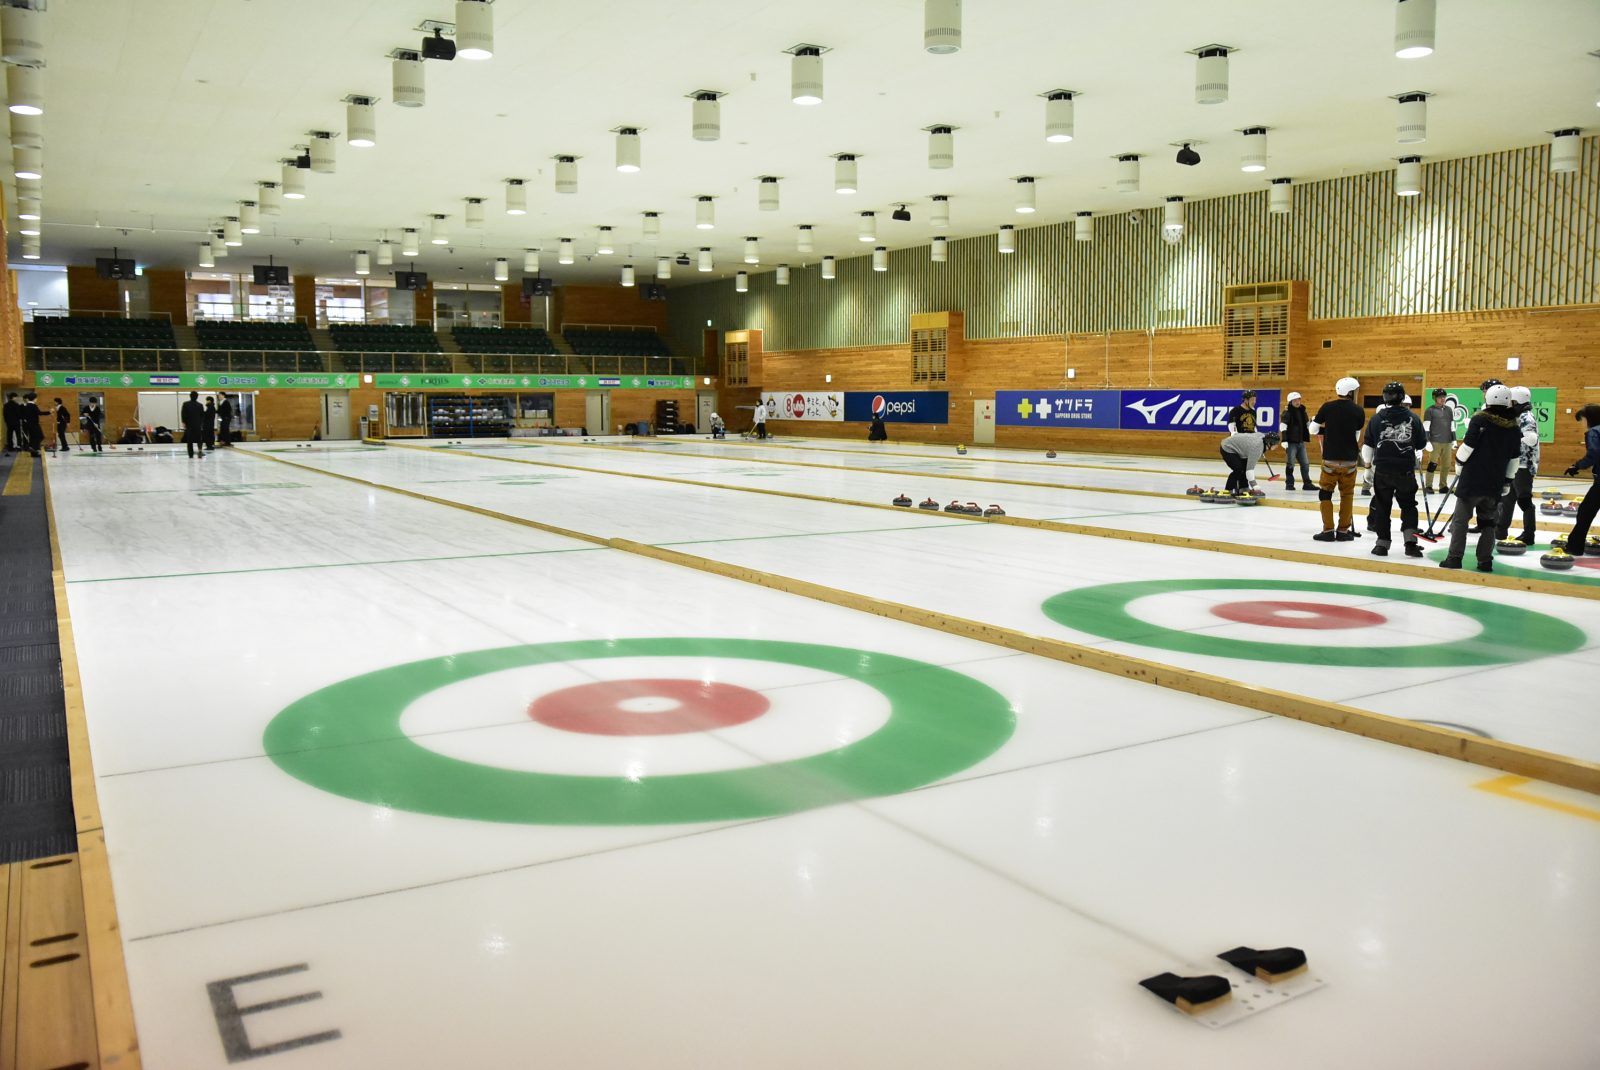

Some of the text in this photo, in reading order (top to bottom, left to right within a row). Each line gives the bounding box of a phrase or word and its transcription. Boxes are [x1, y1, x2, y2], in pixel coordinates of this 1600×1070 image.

[886, 399, 916, 415] pepsi
[1054, 398, 1093, 411] サツドラ
[1081, 412, 1092, 420] STORE
[206, 962, 343, 1064] E
